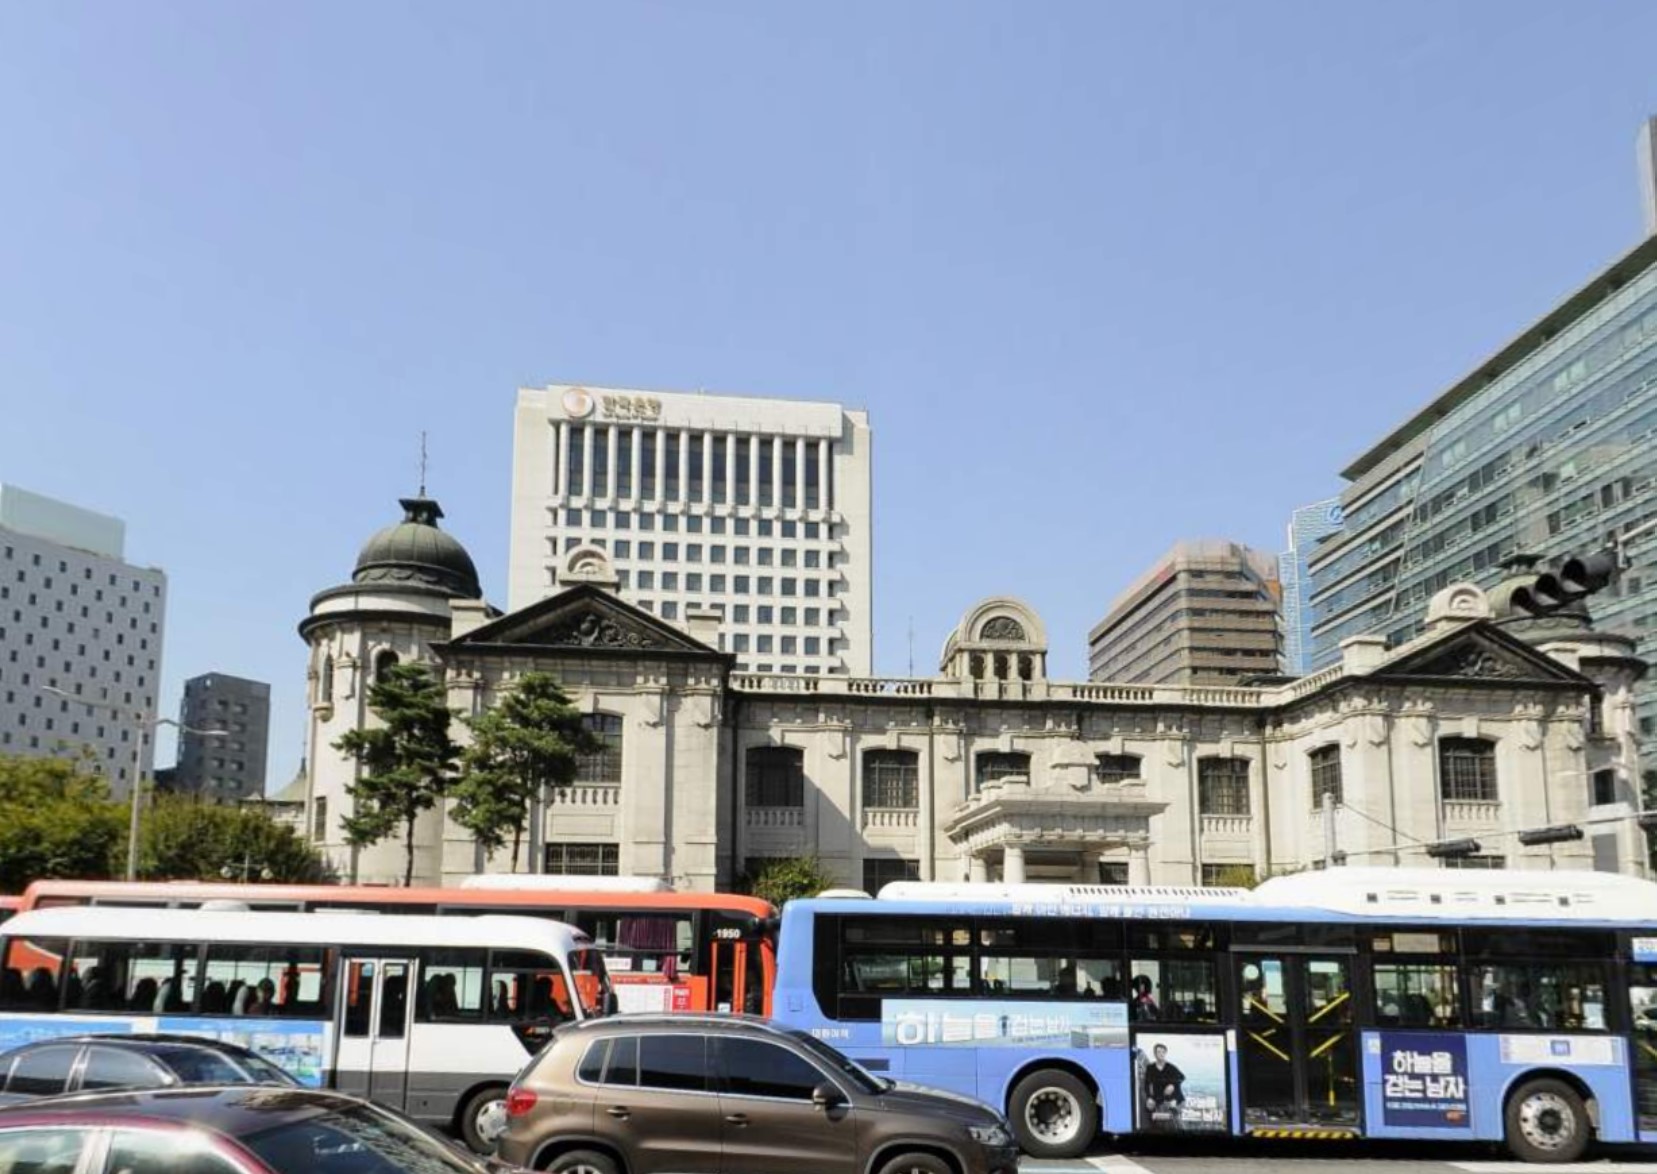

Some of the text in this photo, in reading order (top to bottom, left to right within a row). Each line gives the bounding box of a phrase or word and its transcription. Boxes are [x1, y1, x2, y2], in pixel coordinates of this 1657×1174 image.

[716, 928, 742, 939] 1950
[896, 1013, 999, 1045] 하늘을
[1391, 1049, 1453, 1075] 하늘을
[1384, 1075, 1466, 1099] 걷는 남자
